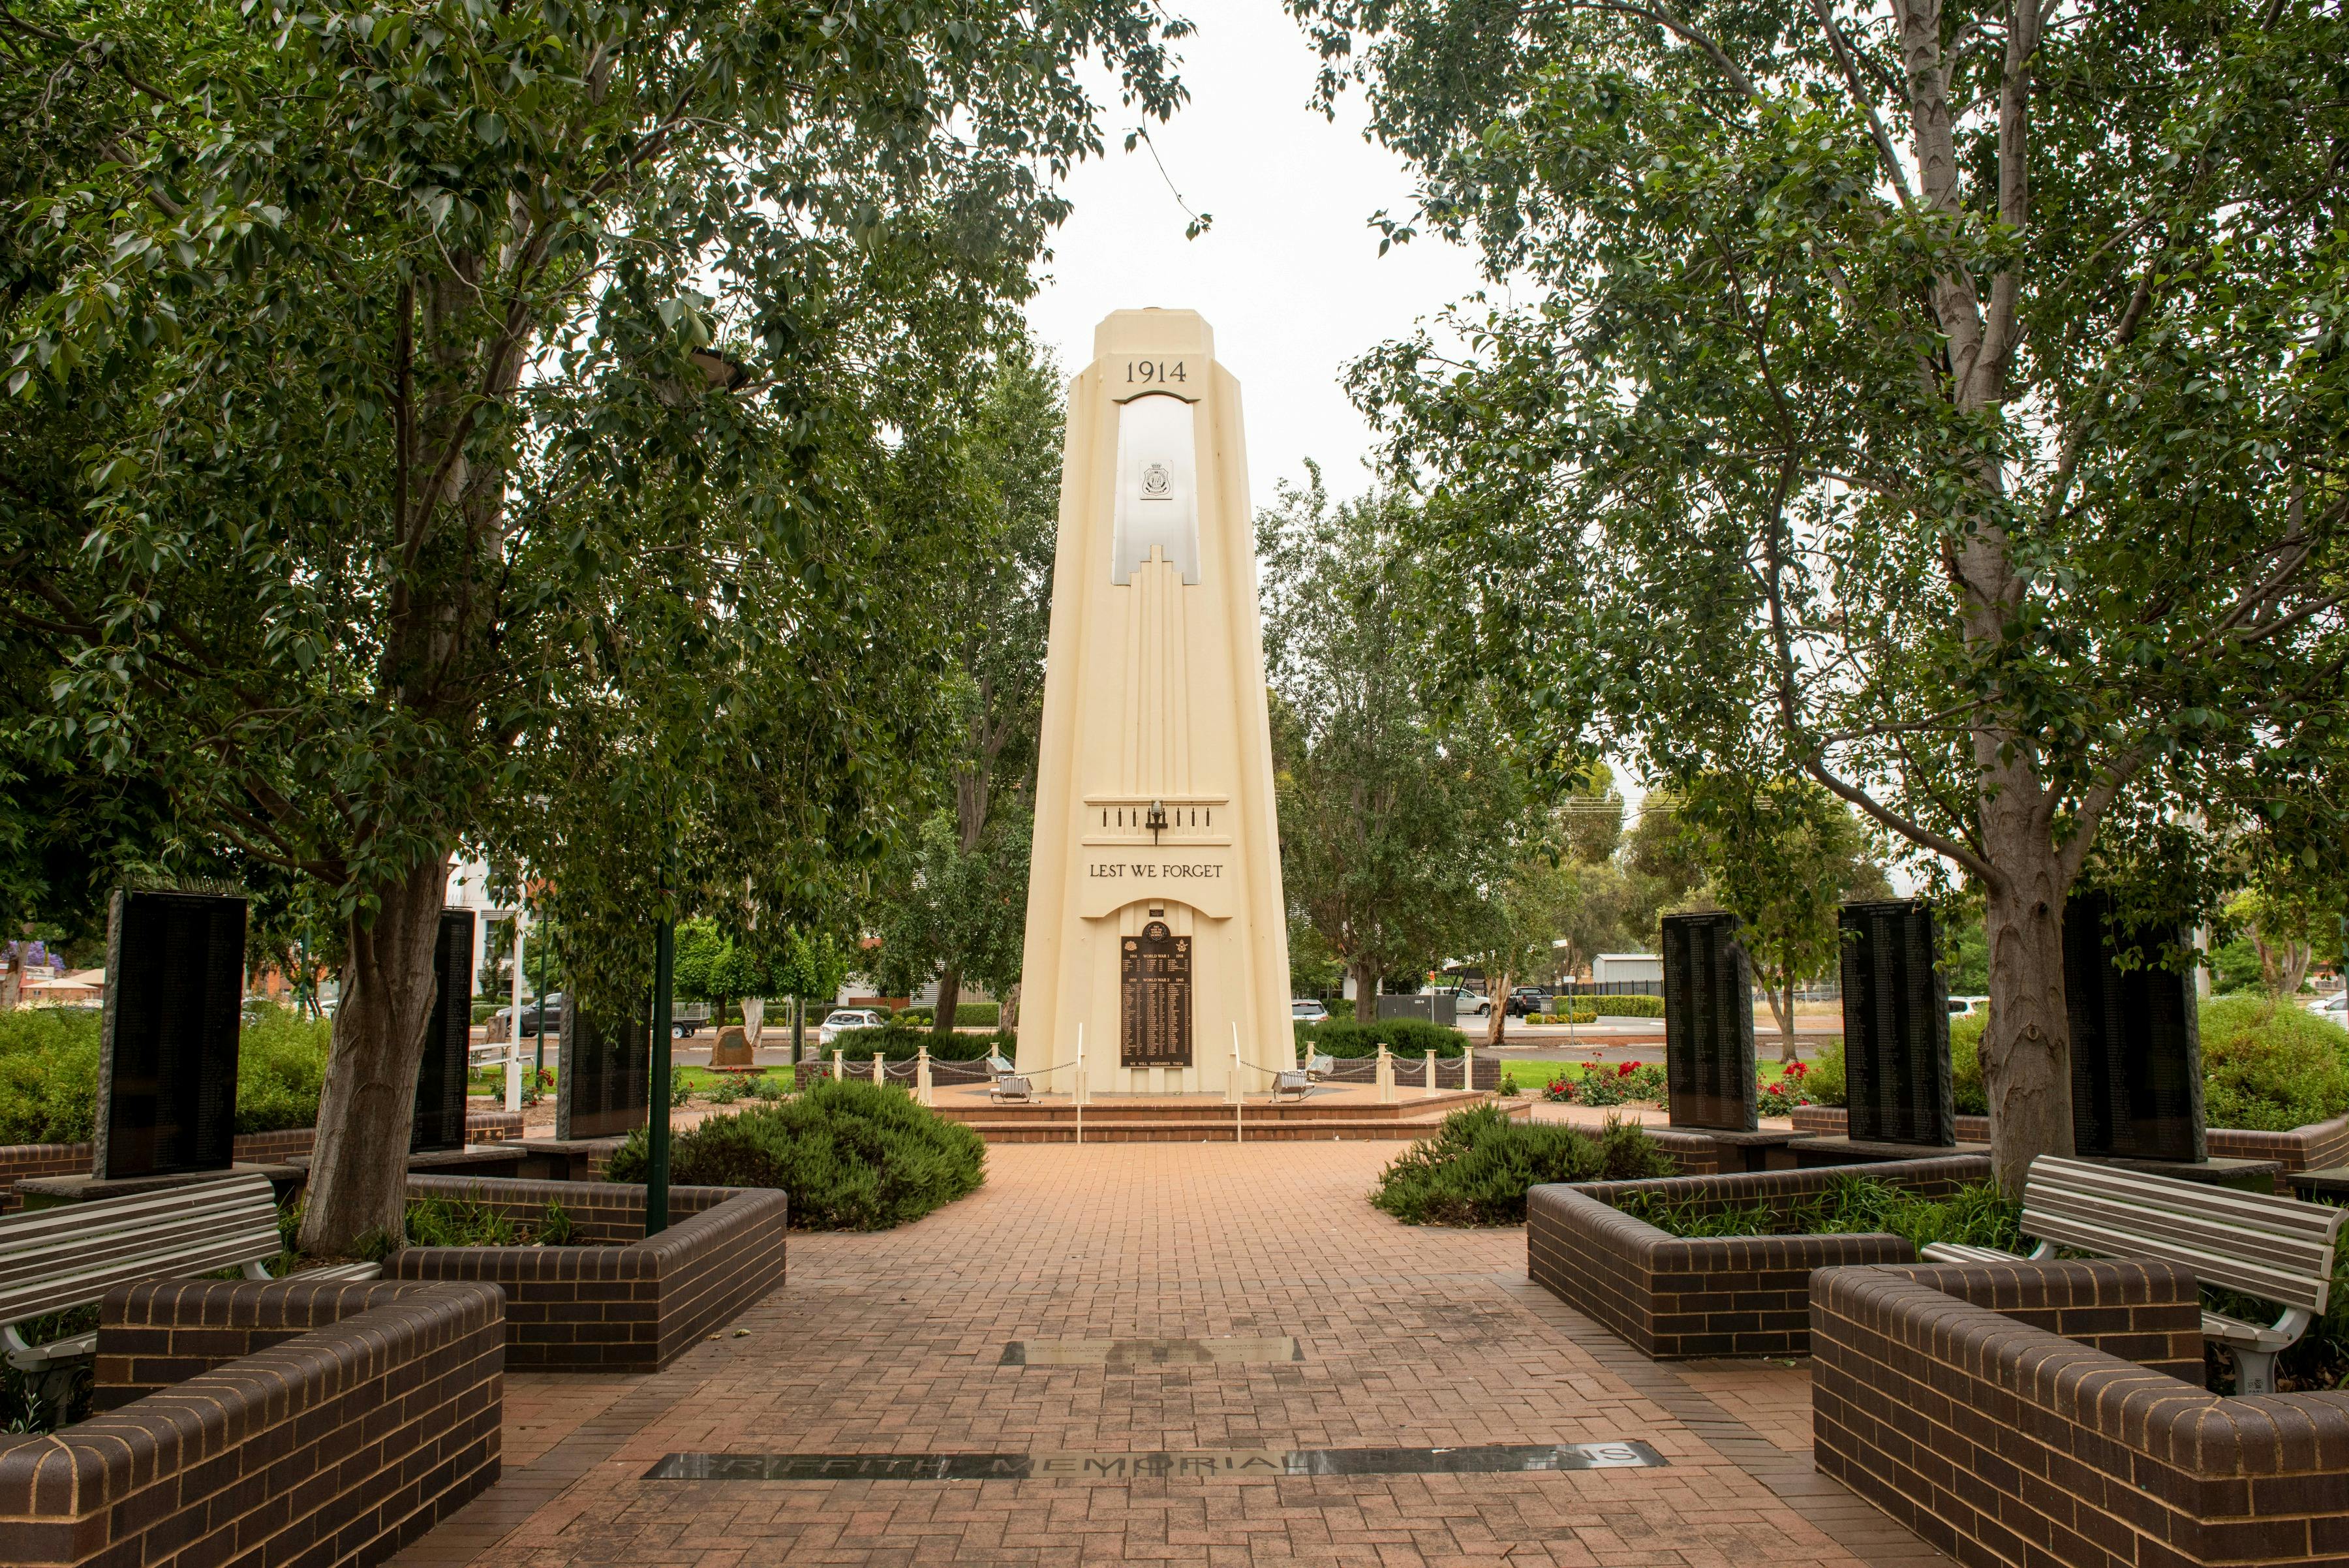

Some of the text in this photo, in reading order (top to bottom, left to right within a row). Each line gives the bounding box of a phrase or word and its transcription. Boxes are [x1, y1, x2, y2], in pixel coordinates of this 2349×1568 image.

[1126, 361, 1186, 384] 1914
[1090, 864, 1223, 878] LEST WE FORGET
[1541, 1003, 1552, 1012] QUEST
[679, 1458, 951, 1473] GRIFFITH
[990, 1456, 1308, 1473] MEMORIAL
